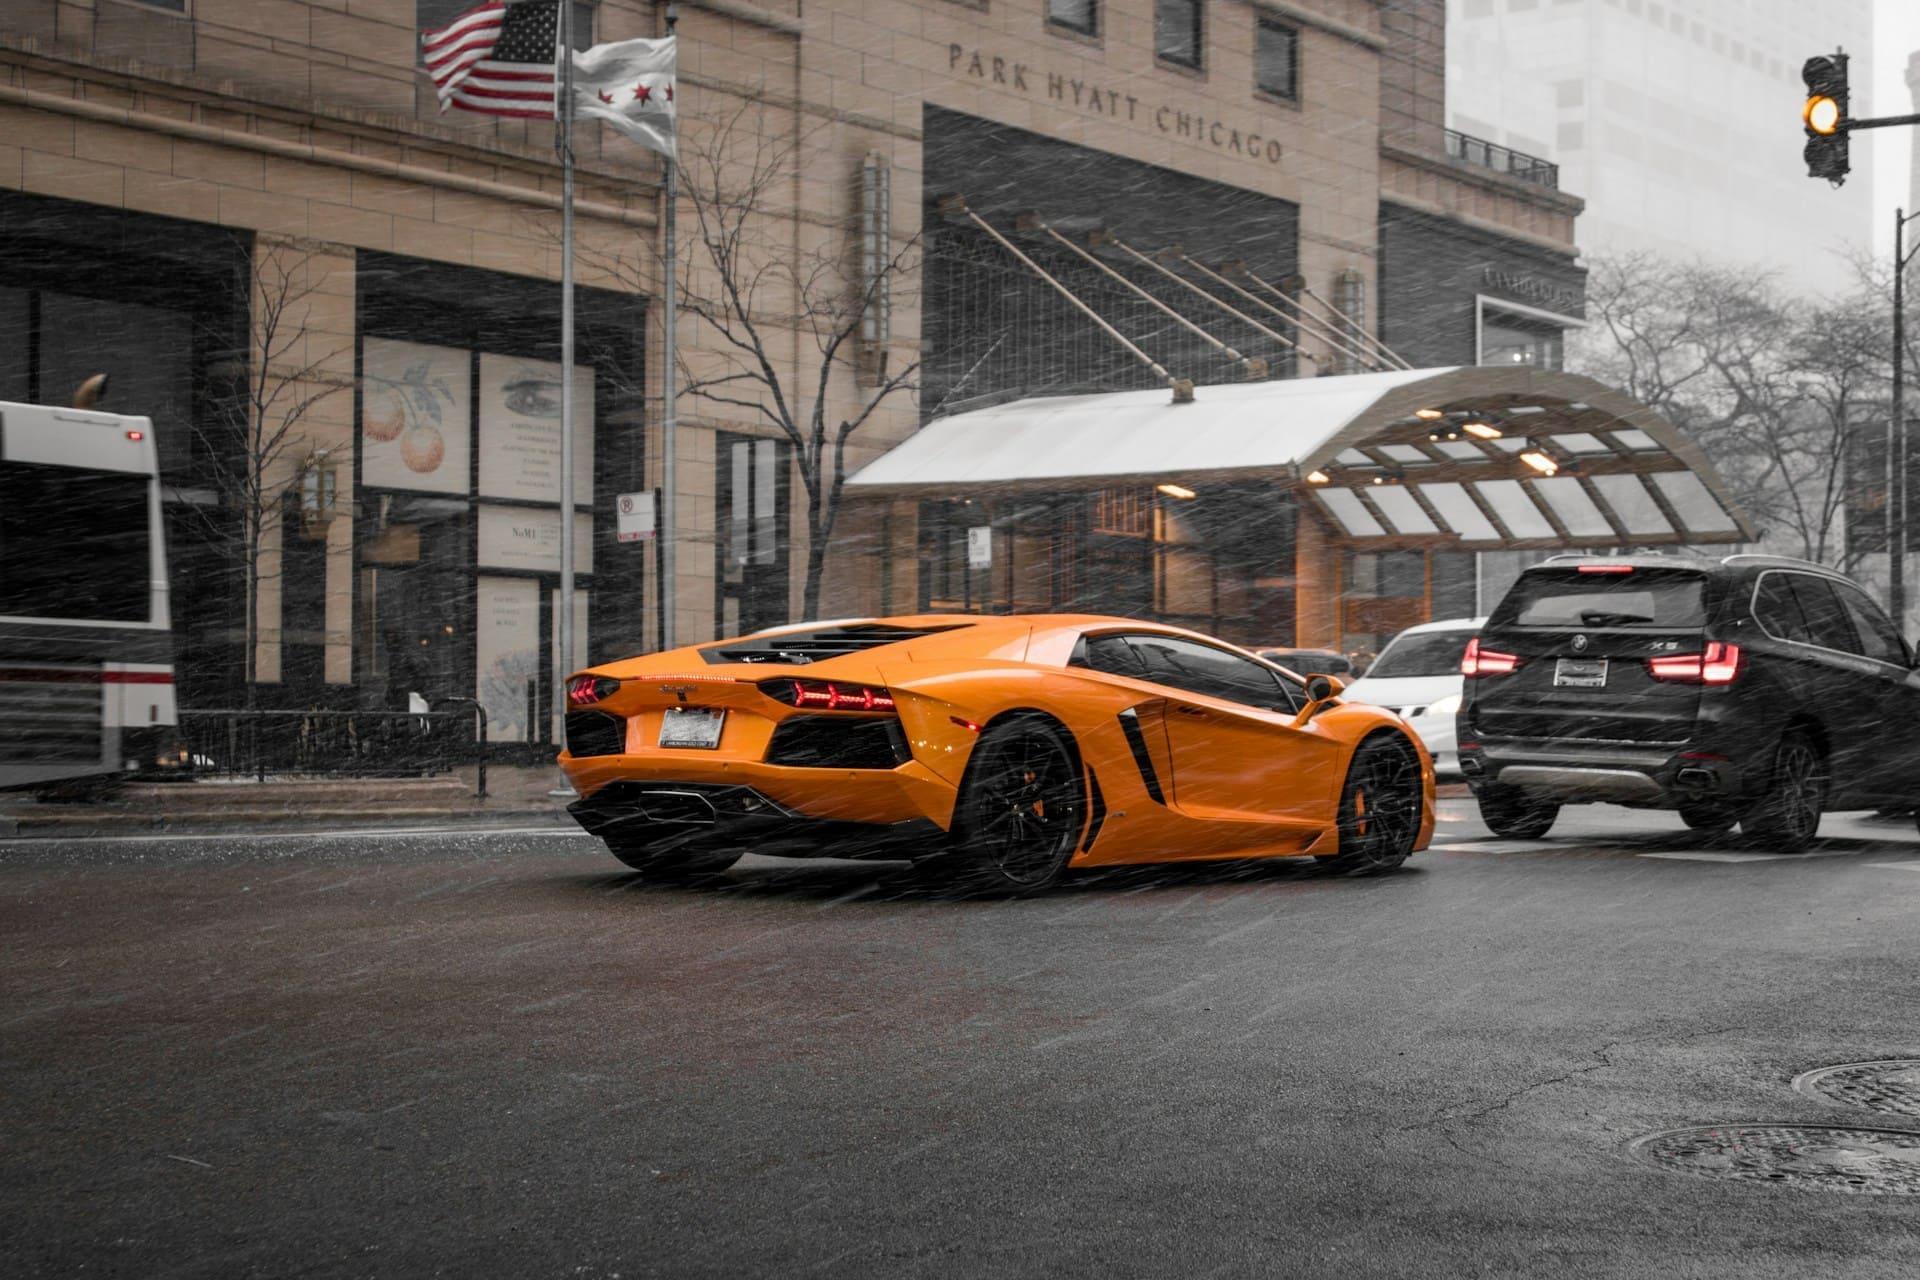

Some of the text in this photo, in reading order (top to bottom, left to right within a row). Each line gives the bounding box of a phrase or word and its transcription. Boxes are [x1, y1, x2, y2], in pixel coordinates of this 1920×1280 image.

[949, 43, 1283, 164] PARK HYATT CHICAGO
